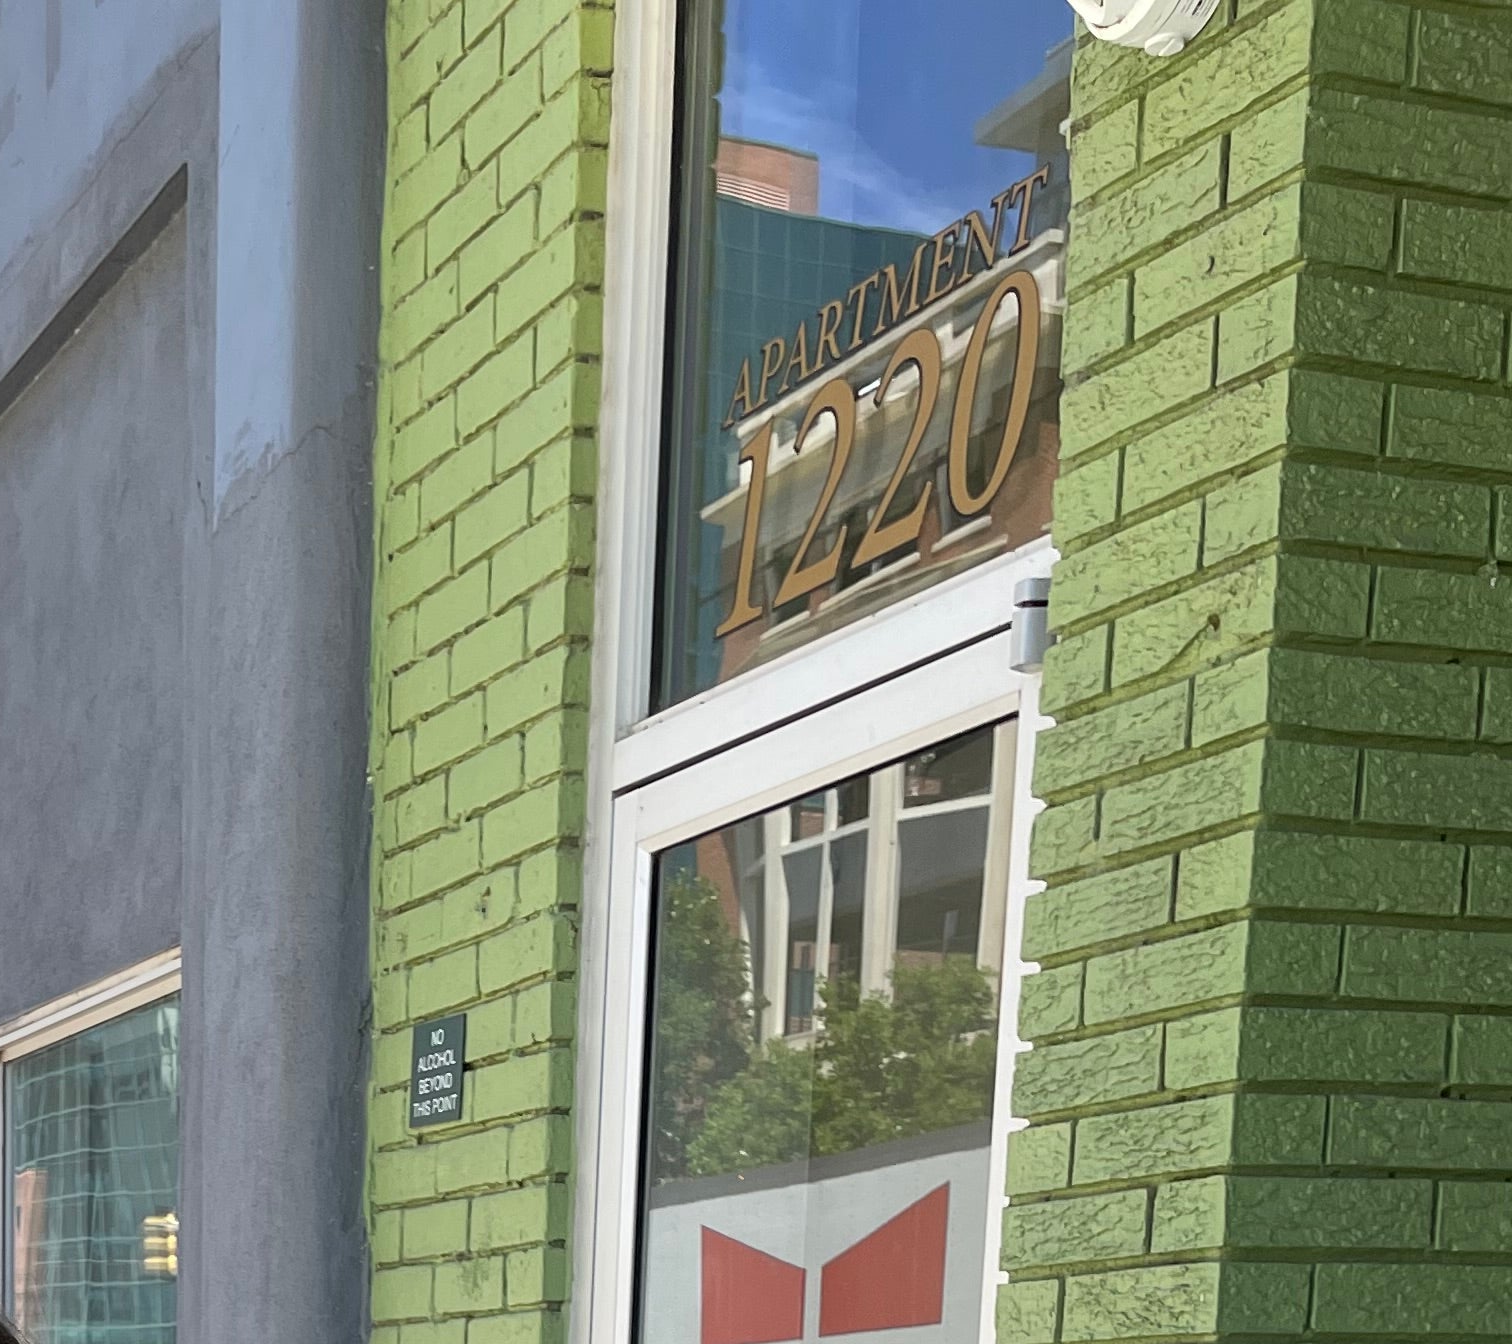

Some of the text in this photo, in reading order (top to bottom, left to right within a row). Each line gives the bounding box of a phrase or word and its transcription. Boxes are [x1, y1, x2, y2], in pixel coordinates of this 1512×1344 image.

[721, 165, 1051, 431] APARTMENT
[715, 270, 1041, 637] 1220
[430, 1028, 445, 1046] NO
[417, 1049, 456, 1072] ALCOHOL
[418, 1072, 453, 1095] BEYOND
[413, 1094, 458, 1117] THIS POINT
